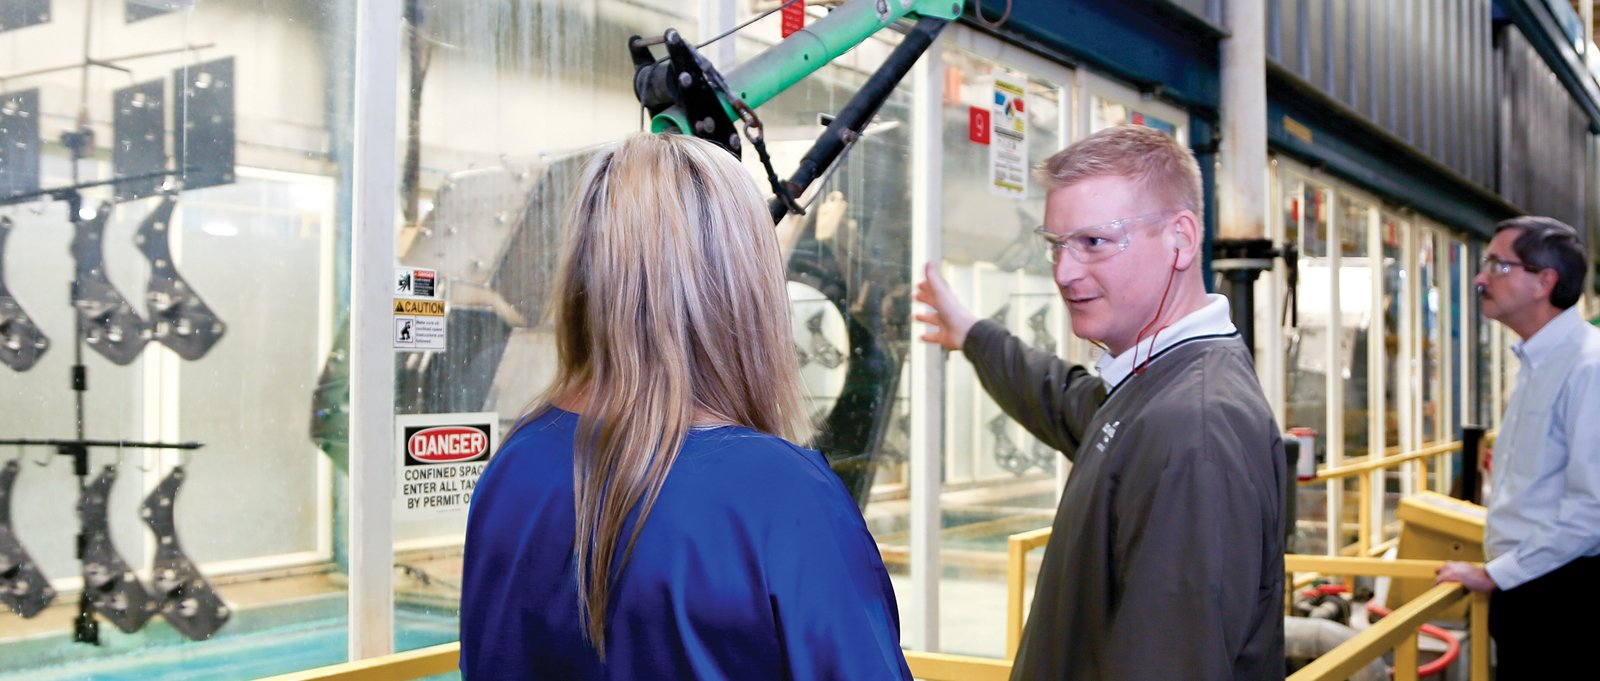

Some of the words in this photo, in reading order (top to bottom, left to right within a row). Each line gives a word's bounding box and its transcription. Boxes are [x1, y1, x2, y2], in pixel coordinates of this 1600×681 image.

[976, 113, 984, 137] 9
[405, 301, 444, 313] CAUTION
[414, 433, 482, 456] DANGER
[405, 467, 457, 481] CONFINED
[460, 465, 484, 477] SPAC
[403, 482, 436, 495] ENTER
[440, 481, 457, 492] ALL
[460, 479, 477, 490] TAN
[408, 498, 420, 509] BY
[424, 494, 460, 507] PERMIT
